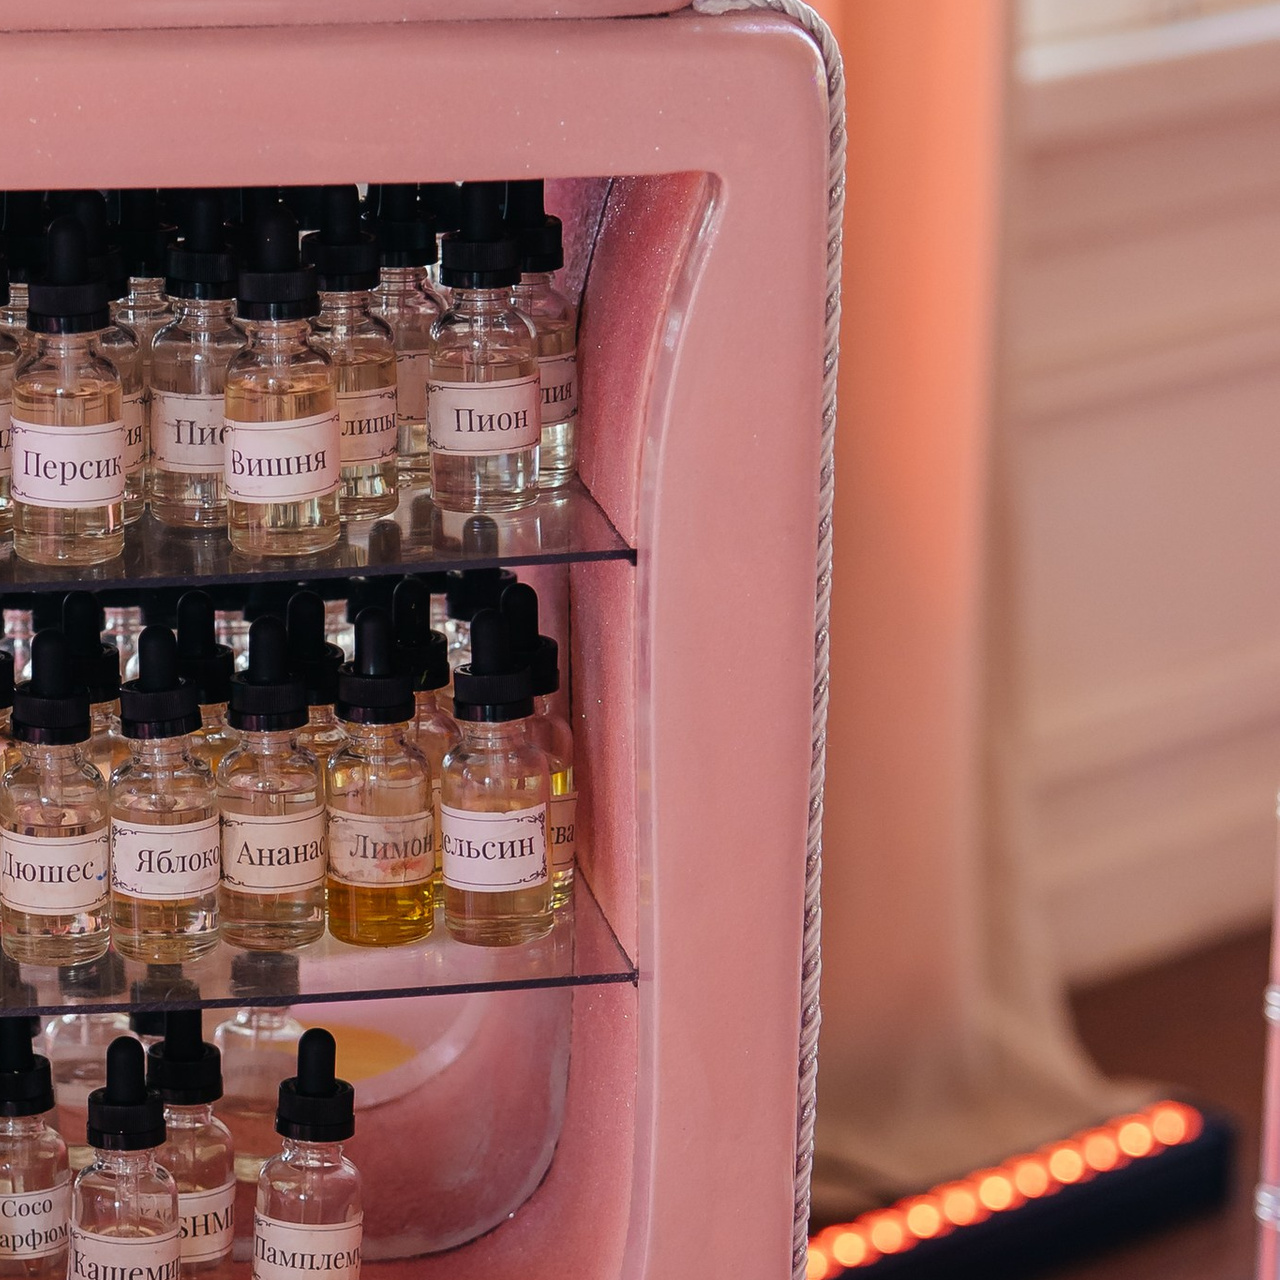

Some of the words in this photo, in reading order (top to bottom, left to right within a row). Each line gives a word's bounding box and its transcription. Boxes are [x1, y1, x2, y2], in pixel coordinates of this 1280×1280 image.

[341, 414, 397, 436] липы
[454, 408, 528, 433] Пион
[23, 449, 122, 486] Персик
[231, 449, 327, 477] Вишня
[135, 846, 219, 873] Яблоко
[237, 836, 324, 866] Ананас
[350, 832, 432, 860] Лимон
[3, 850, 94, 883] Дюшес
